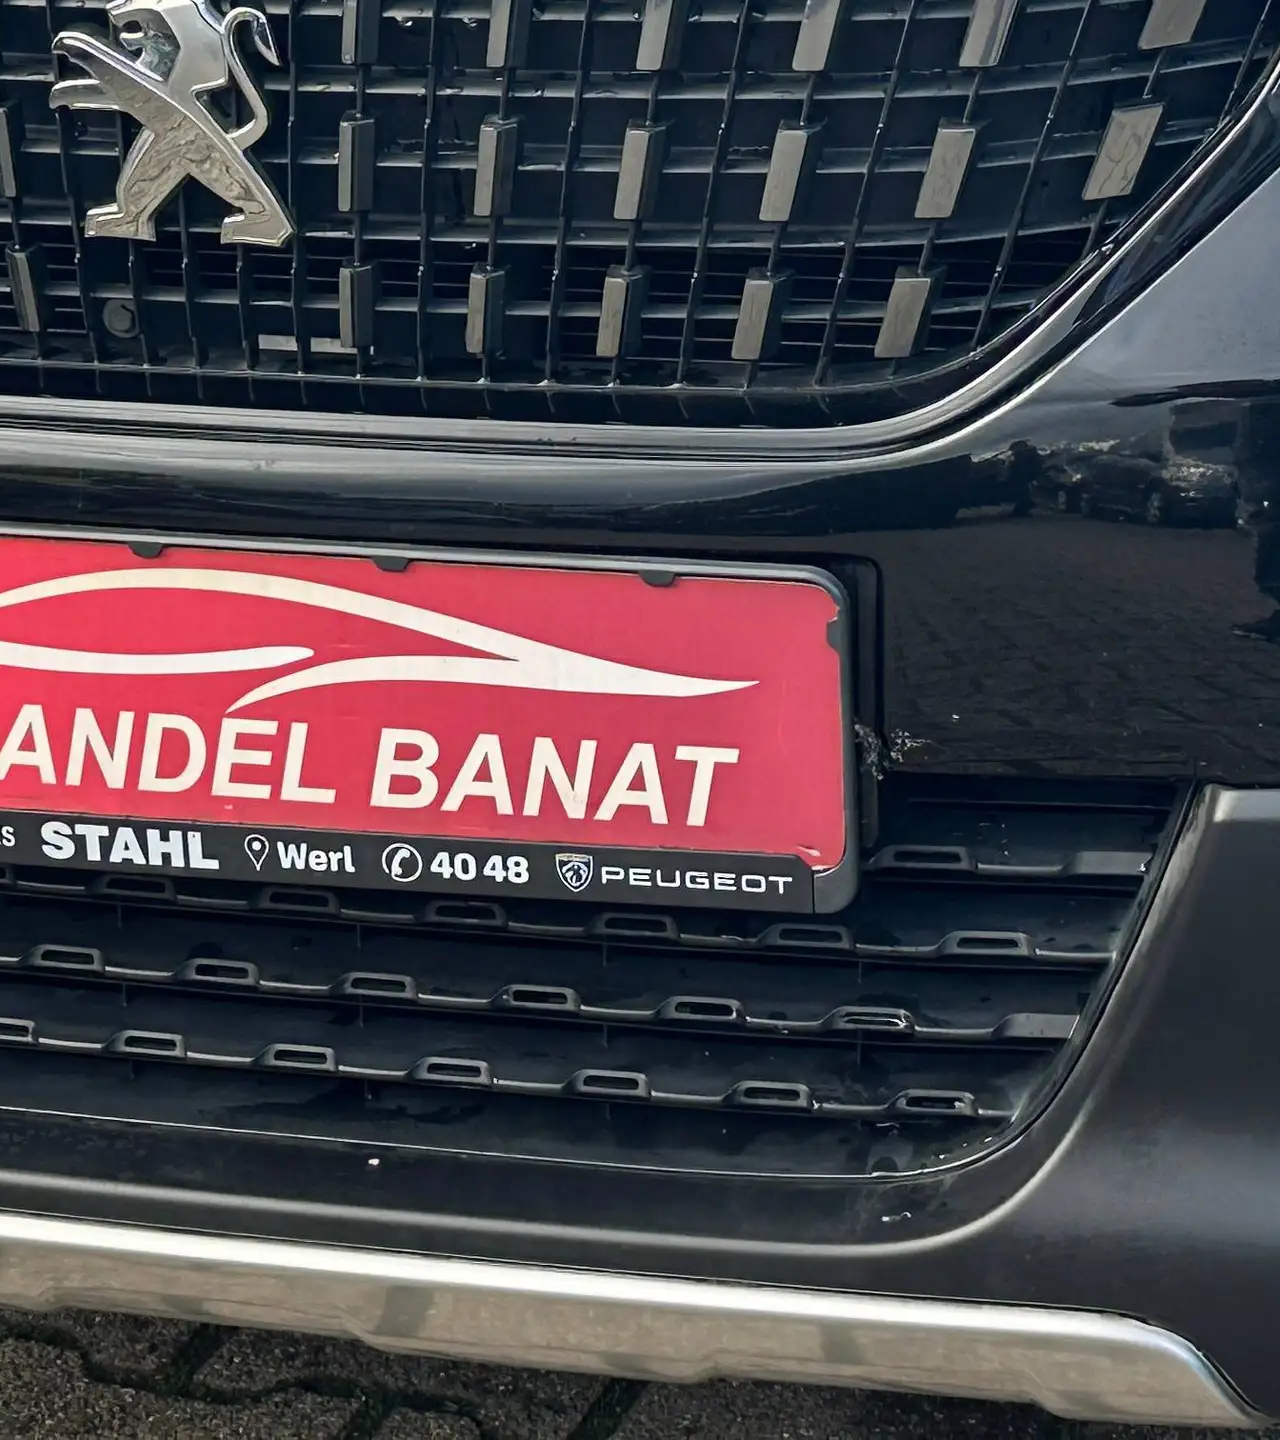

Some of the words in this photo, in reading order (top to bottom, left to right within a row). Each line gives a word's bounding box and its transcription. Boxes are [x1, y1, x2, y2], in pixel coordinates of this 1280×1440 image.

[370, 728, 740, 827] BANAT
[40, 821, 220, 870] STAHL
[277, 841, 356, 873] Werl
[602, 867, 793, 895] PEUGEOT
